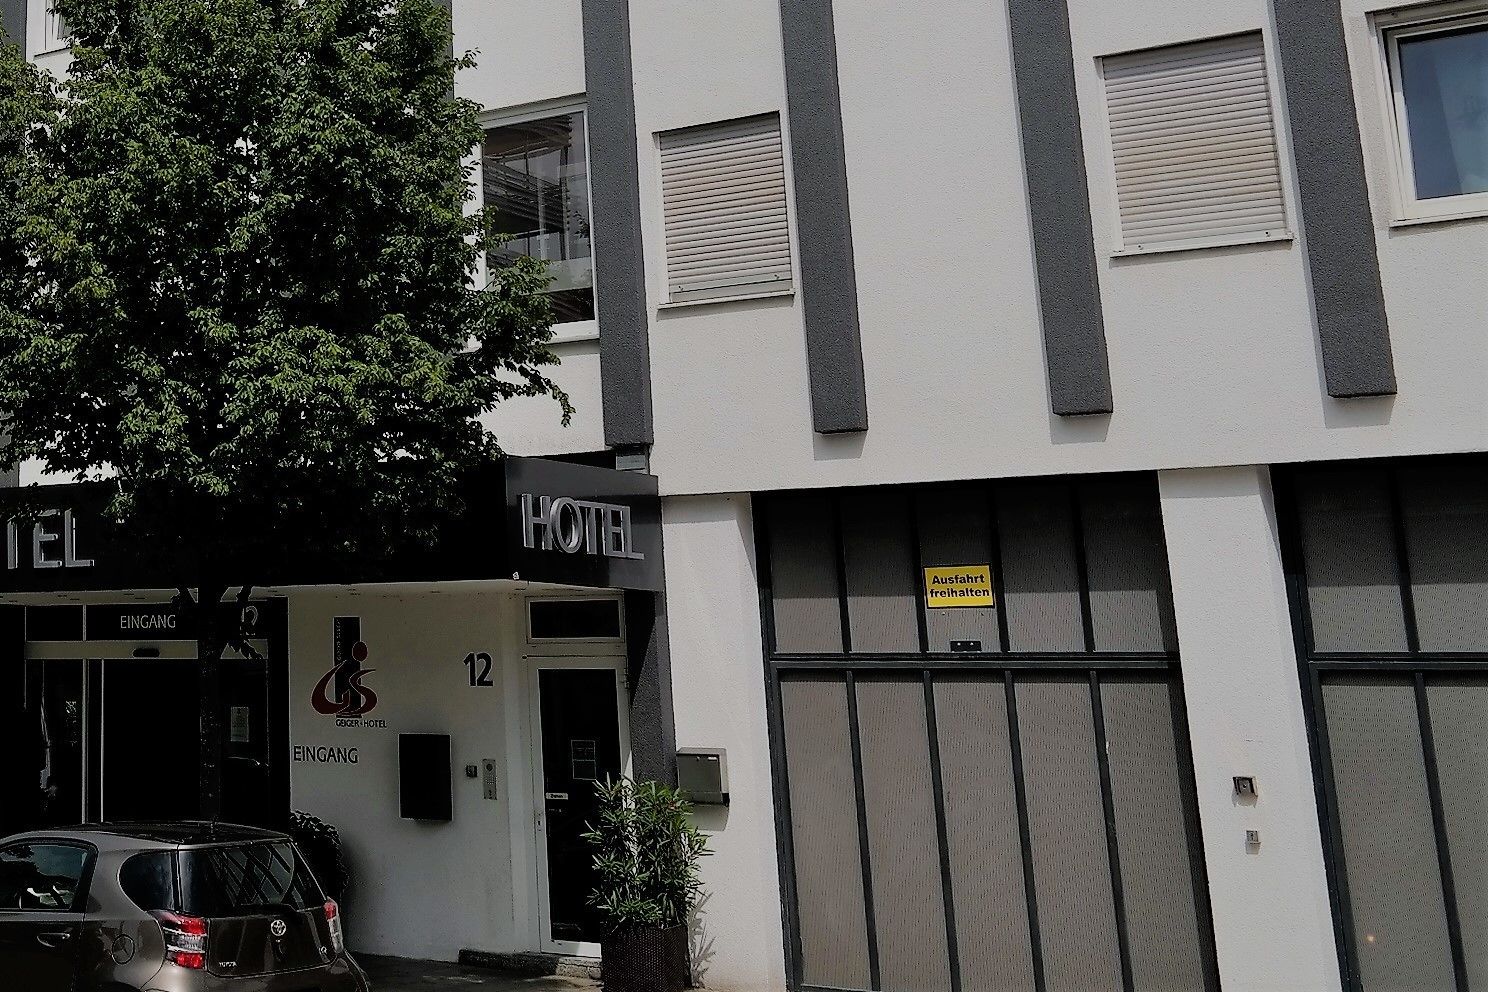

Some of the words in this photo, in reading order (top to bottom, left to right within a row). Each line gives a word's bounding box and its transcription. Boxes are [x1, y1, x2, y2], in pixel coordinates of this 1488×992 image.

[521, 493, 645, 560] HOTEL
[932, 574, 985, 585] Ausfahrt
[930, 588, 990, 598] freihalten
[120, 614, 176, 629] EINGANG
[463, 652, 493, 686] 12
[293, 745, 358, 764] EINGANG
